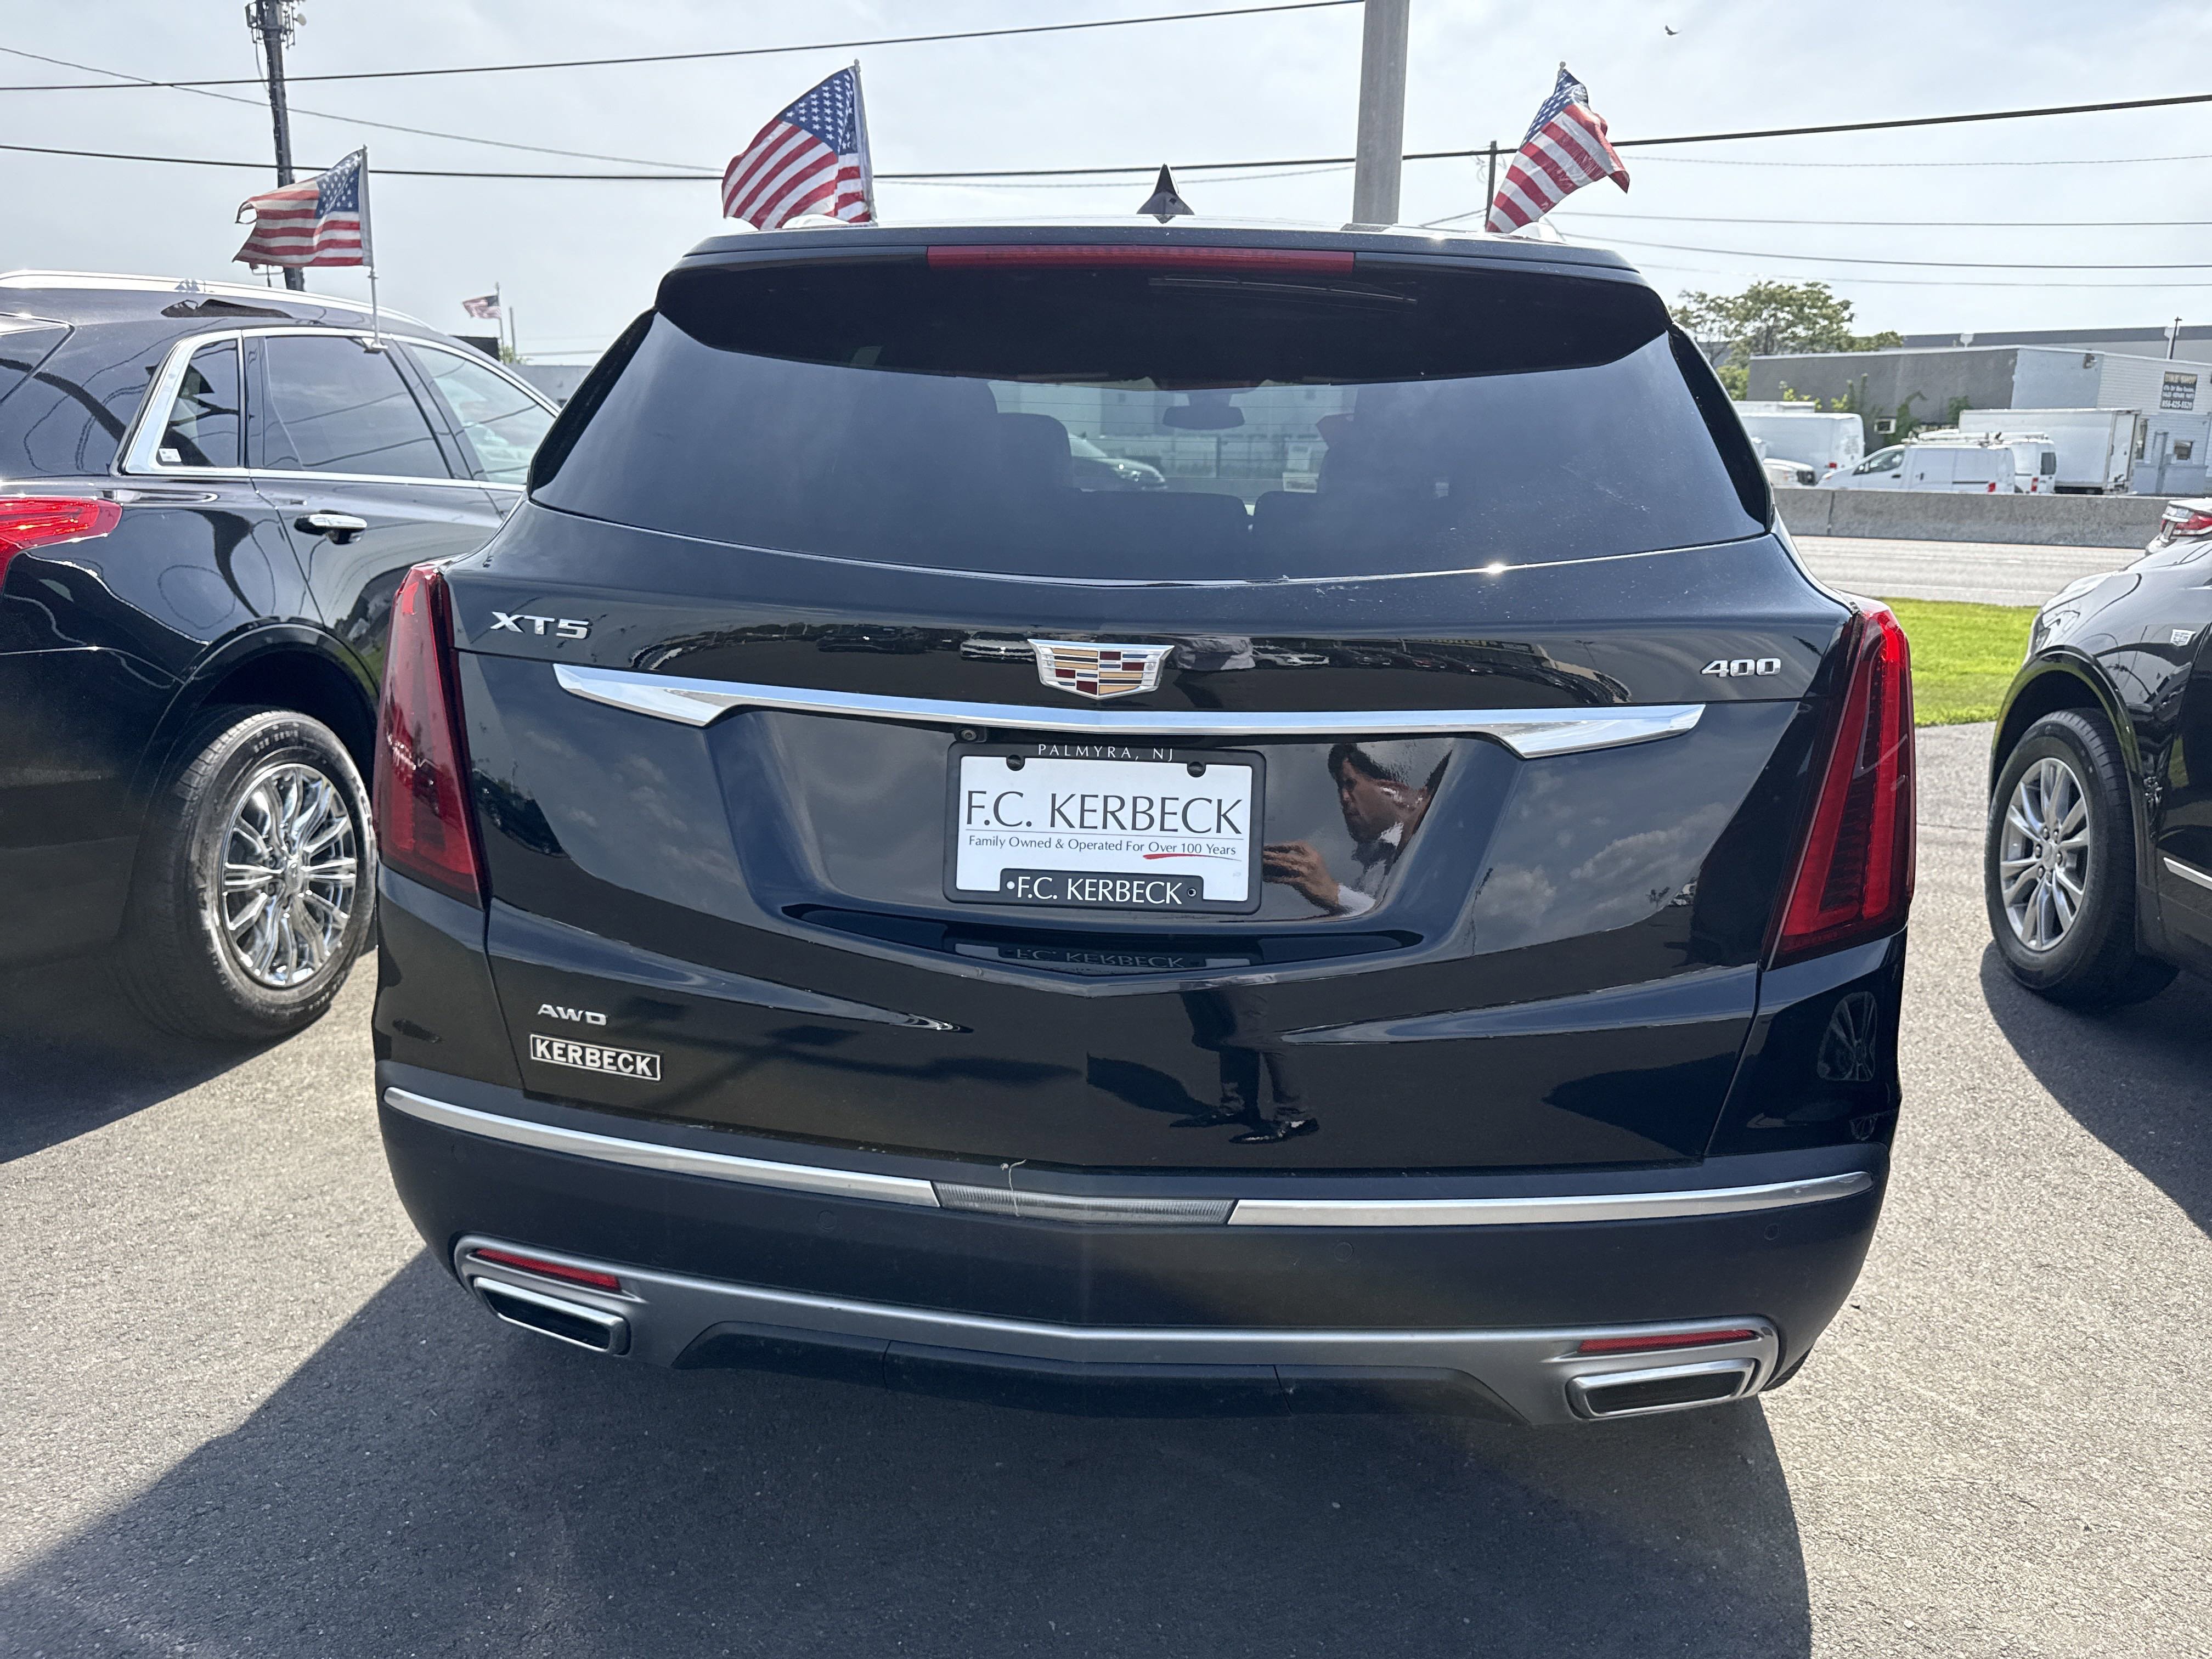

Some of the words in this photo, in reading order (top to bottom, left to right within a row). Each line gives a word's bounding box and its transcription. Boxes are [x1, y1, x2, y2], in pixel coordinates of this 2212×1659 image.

[490, 611, 589, 639] XT5
[1701, 658, 1781, 678] 400
[1038, 744, 1139, 761] PALMYRA,
[1153, 748, 1173, 761] NJ
[967, 791, 1032, 827] F.C.
[1050, 793, 1243, 834] KERBECK
[969, 835, 1006, 849] Family
[1009, 837, 1052, 848] Owned
[1055, 838, 1064, 849] &
[1068, 839, 1122, 853] Operated
[1126, 841, 1145, 851] For
[1148, 842, 1177, 853] Over
[1181, 843, 1202, 854] 100
[1206, 844, 1236, 855] Years
[1017, 877, 1058, 900] F.C.
[1067, 879, 1182, 905] KERBECK
[537, 1003, 607, 1026] AWD
[536, 1039, 653, 1076] KERBECK
